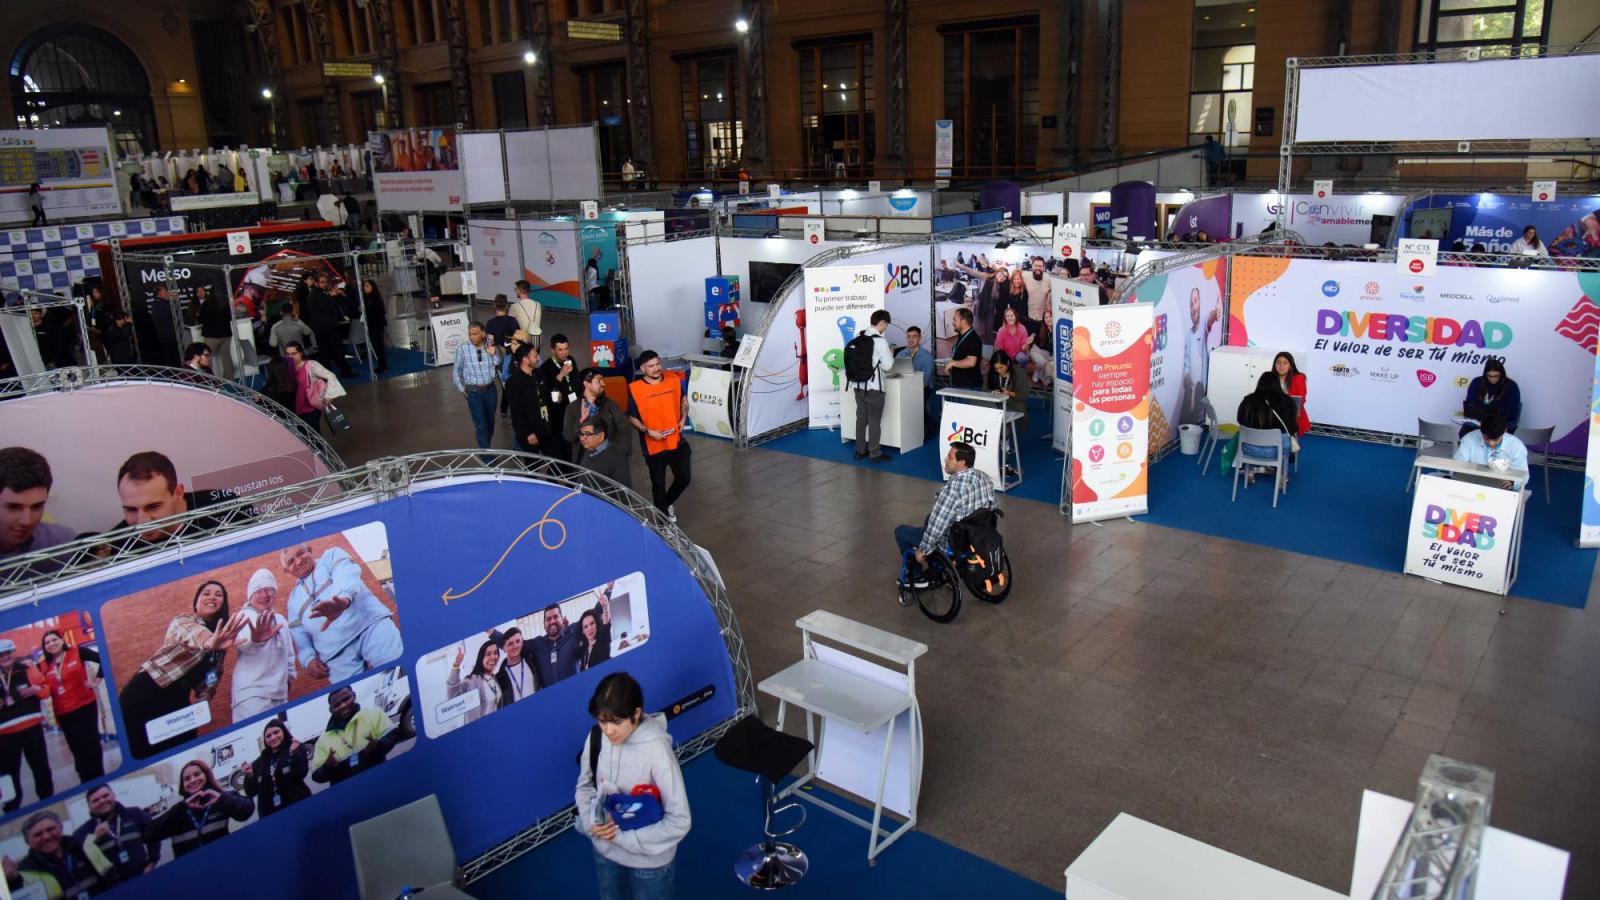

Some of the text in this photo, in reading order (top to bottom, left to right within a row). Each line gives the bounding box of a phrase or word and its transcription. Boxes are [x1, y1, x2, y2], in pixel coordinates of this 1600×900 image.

[1465, 225, 1513, 238] Más de
[140, 267, 191, 284] Metso
[845, 294, 867, 303] trabajo
[814, 304, 834, 312] puede
[440, 319, 461, 327] Metso
[1316, 309, 1513, 350] DIVERSIDAD
[1314, 339, 1329, 351] El
[1375, 345, 1391, 356] de
[1429, 347, 1447, 361] Tú
[1093, 362, 1133, 372] En Preunic
[1098, 371, 1128, 380] siempre
[1370, 371, 1389, 380] MAKE
[1091, 379, 1134, 389] hay espacio
[1092, 385, 1133, 397] para todas
[1088, 393, 1136, 404] las personas
[963, 427, 988, 446] Bci
[210, 475, 284, 500] Si te gustan los
[1424, 503, 1498, 538] DIVER
[1422, 522, 1495, 551] SIDAD
[1429, 542, 1443, 552] El
[1432, 552, 1447, 562] de
[1422, 558, 1483, 579] Tú mismo
[441, 699, 465, 714] Walmart
[166, 711, 194, 726] Walmart
